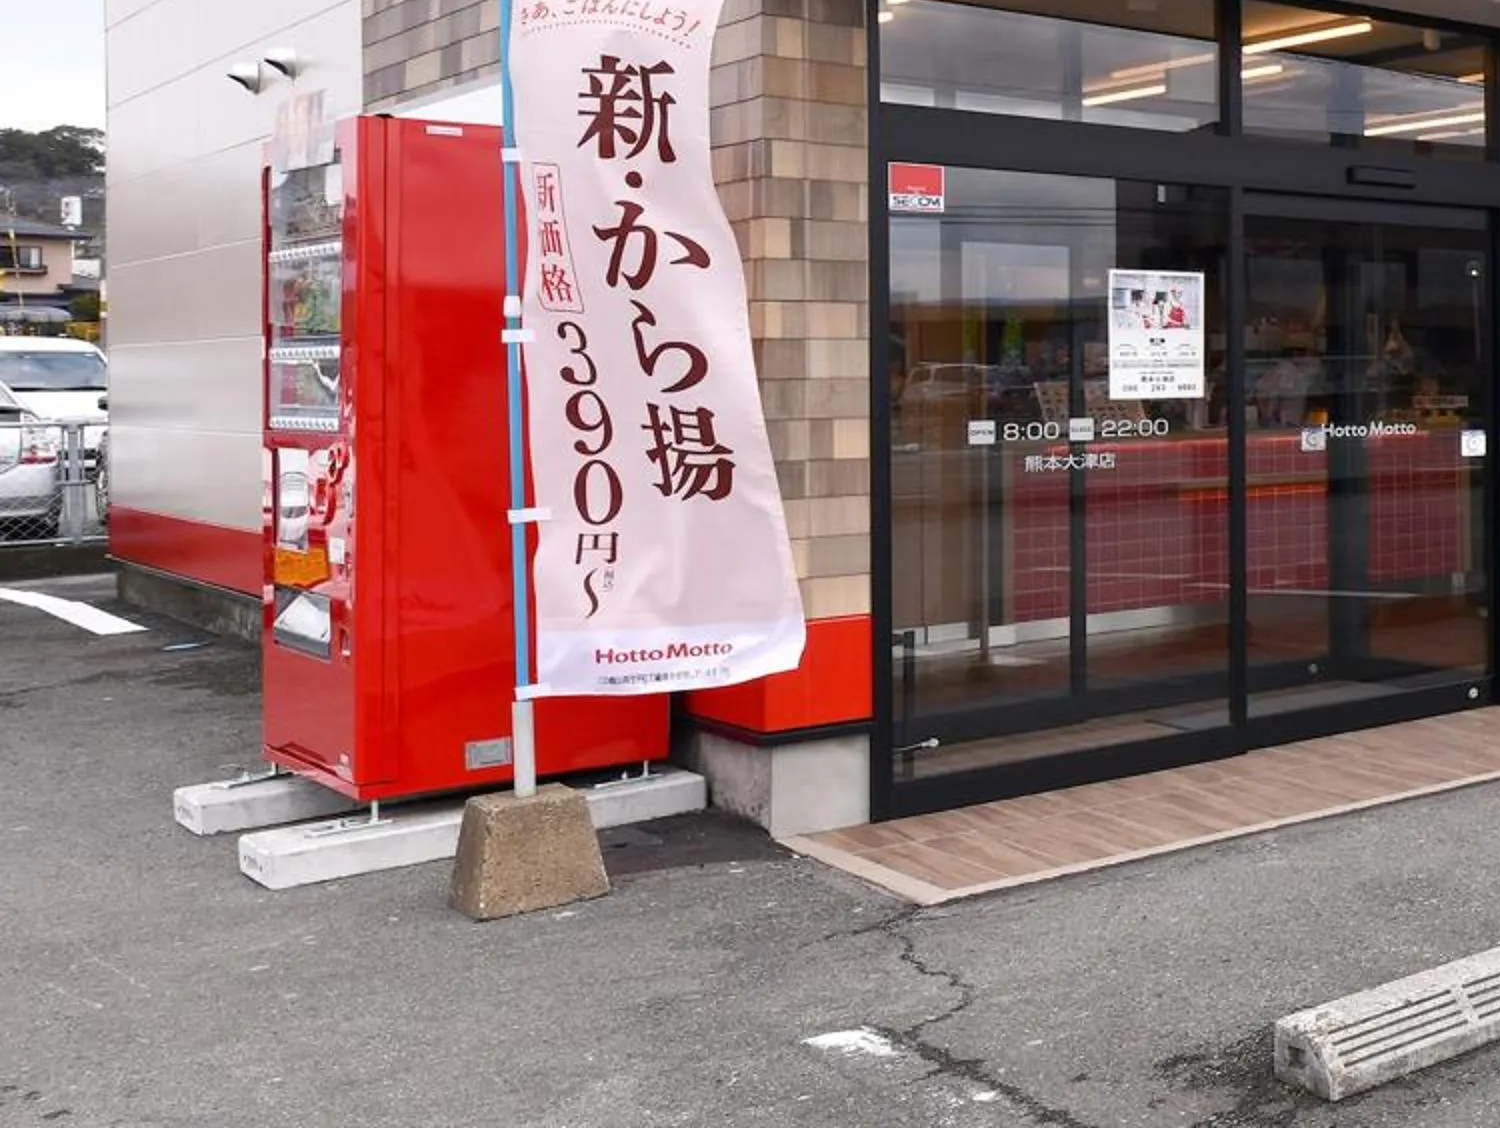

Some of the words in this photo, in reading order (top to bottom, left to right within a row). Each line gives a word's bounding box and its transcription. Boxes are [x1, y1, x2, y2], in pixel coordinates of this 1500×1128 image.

[1003, 421, 1060, 441] 8:00
[1101, 418, 1169, 438] 22:00
[1322, 422, 1368, 438] Hotto
[1369, 420, 1417, 437] Motto
[1024, 453, 1117, 472] 熊本大津店
[595, 645, 664, 664] Hotto
[666, 642, 733, 659] Motto
